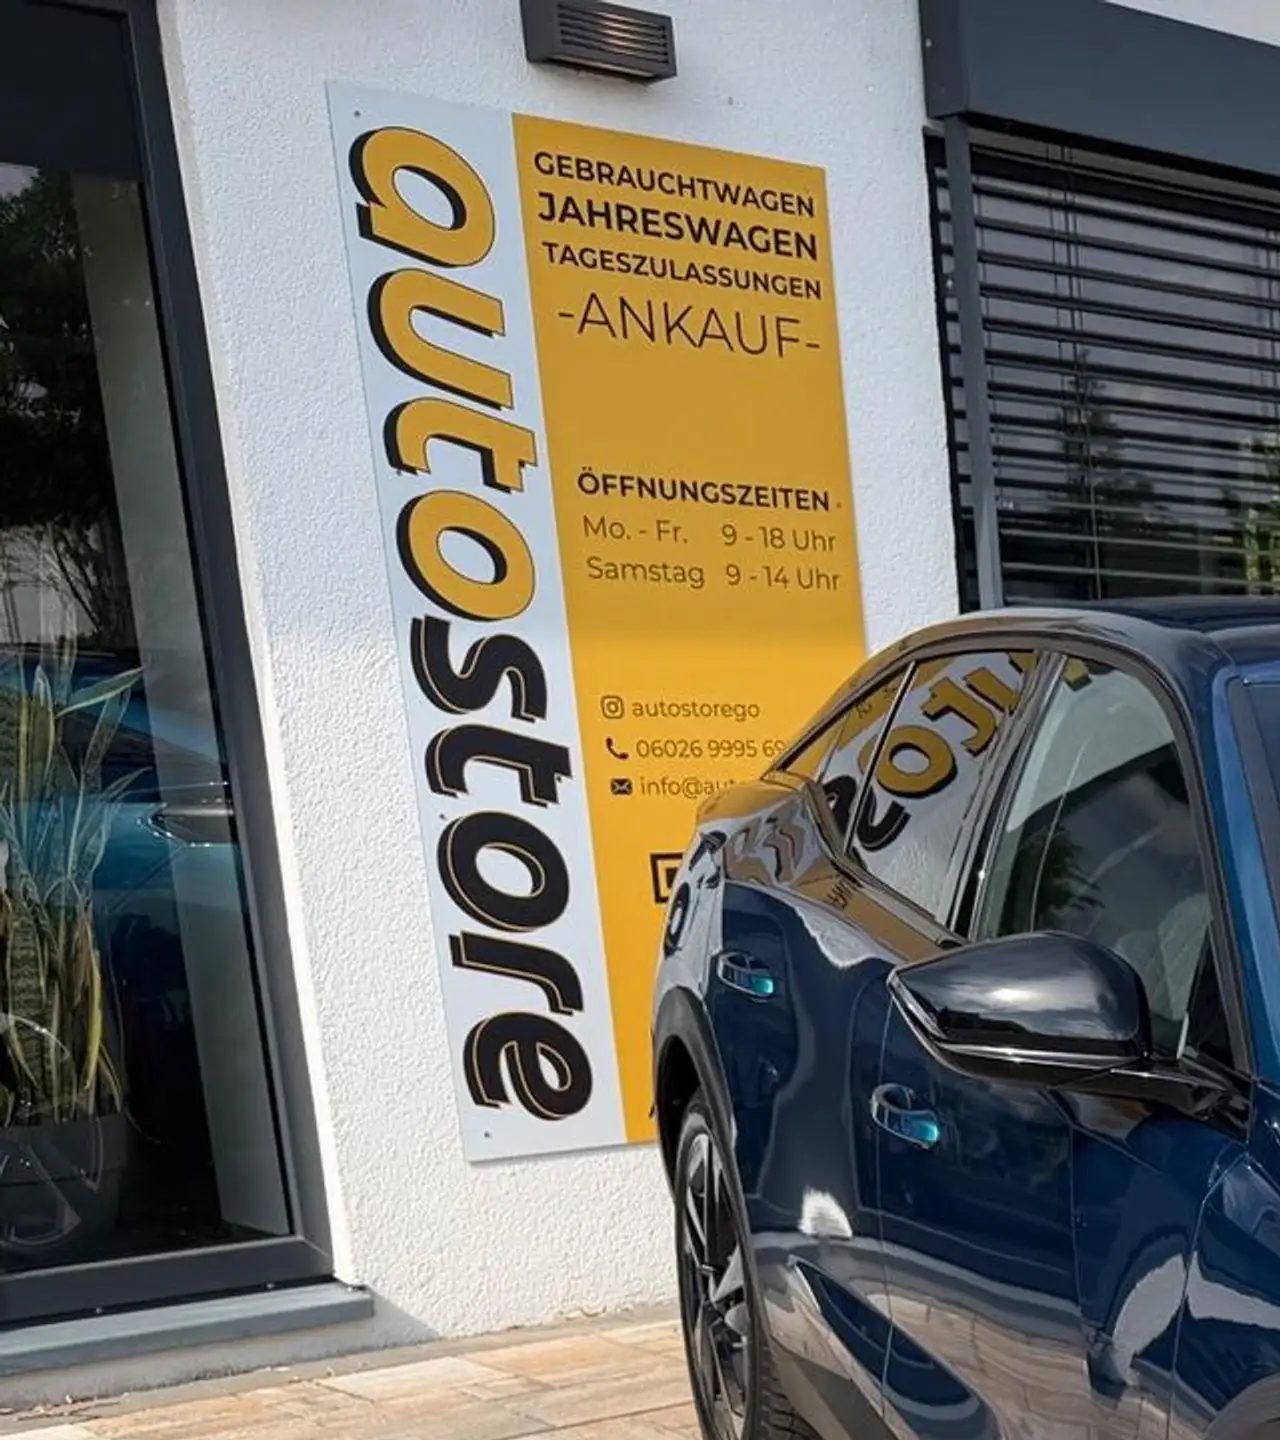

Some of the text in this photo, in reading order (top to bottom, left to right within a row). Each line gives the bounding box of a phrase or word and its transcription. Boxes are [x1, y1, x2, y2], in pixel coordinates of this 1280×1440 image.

[534, 151, 814, 218] GEBRAUCHTWAGEN
[538, 192, 818, 261] JAHRESWAGEN
[542, 242, 821, 300] TAGESZULASSUNGEN
[558, 292, 820, 358] -ANKAUF-
[577, 466, 829, 511] ÖFFNUNGSZEITEN
[583, 515, 631, 540] Mo.
[656, 519, 688, 544] Fr.
[721, 523, 737, 546] 9
[760, 526, 785, 549] 18
[792, 529, 836, 552] Uhr
[586, 556, 705, 589] Samstag
[725, 563, 741, 586] 9
[765, 565, 789, 589] 14
[797, 569, 840, 590] Uhr
[349, 126, 593, 1121] autostore
[632, 700, 760, 722] autostorego
[636, 739, 703, 758] 06026
[707, 739, 757, 758] 9995
